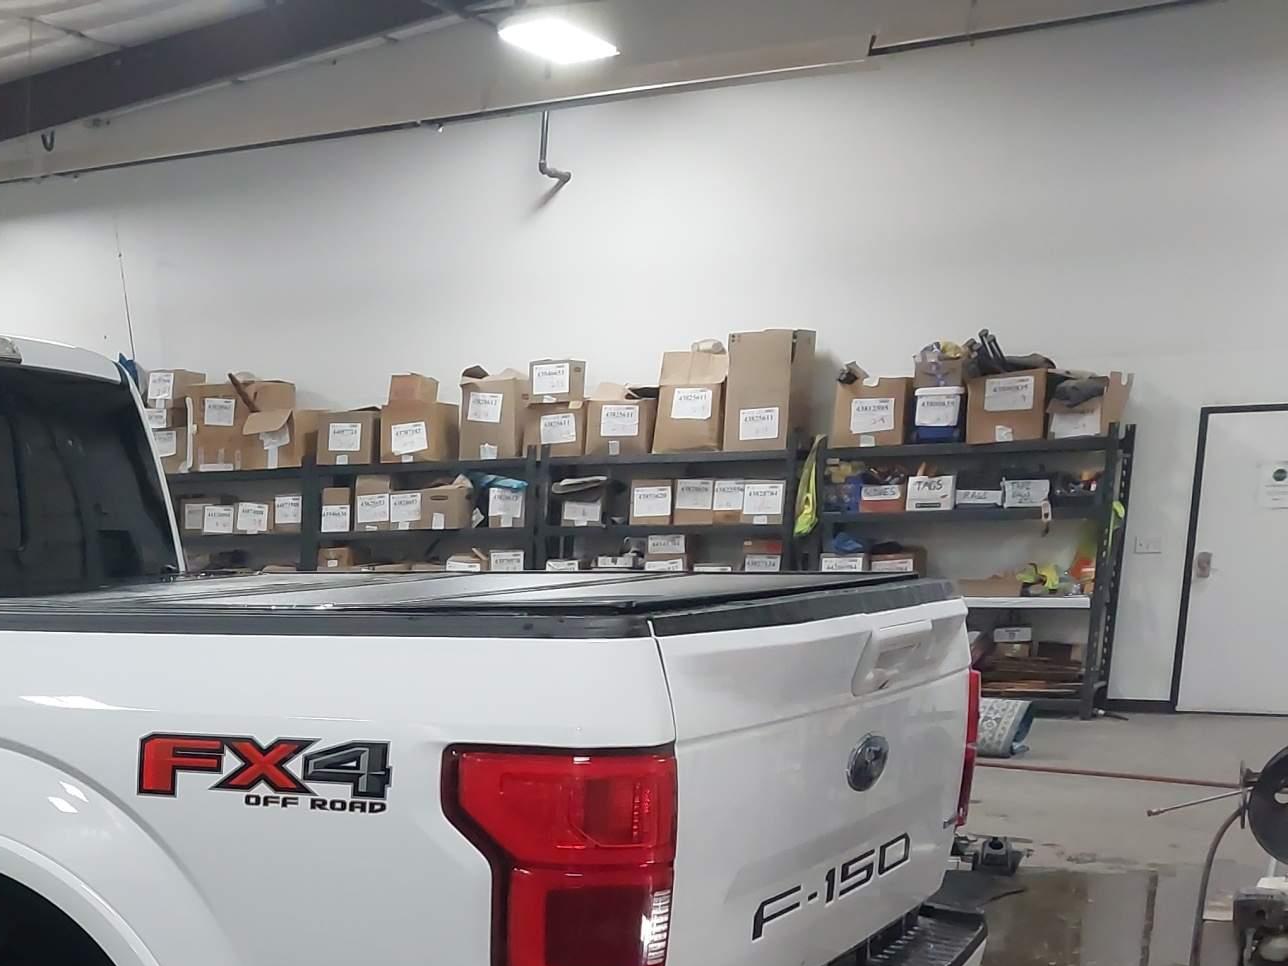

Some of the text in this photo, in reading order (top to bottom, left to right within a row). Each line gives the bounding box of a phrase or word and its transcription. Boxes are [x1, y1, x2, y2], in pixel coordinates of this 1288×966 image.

[915, 480, 943, 492] TAGS
[137, 731, 392, 800] FX4
[244, 794, 387, 814] OFF ROAD
[752, 832, 911, 941] F-150
